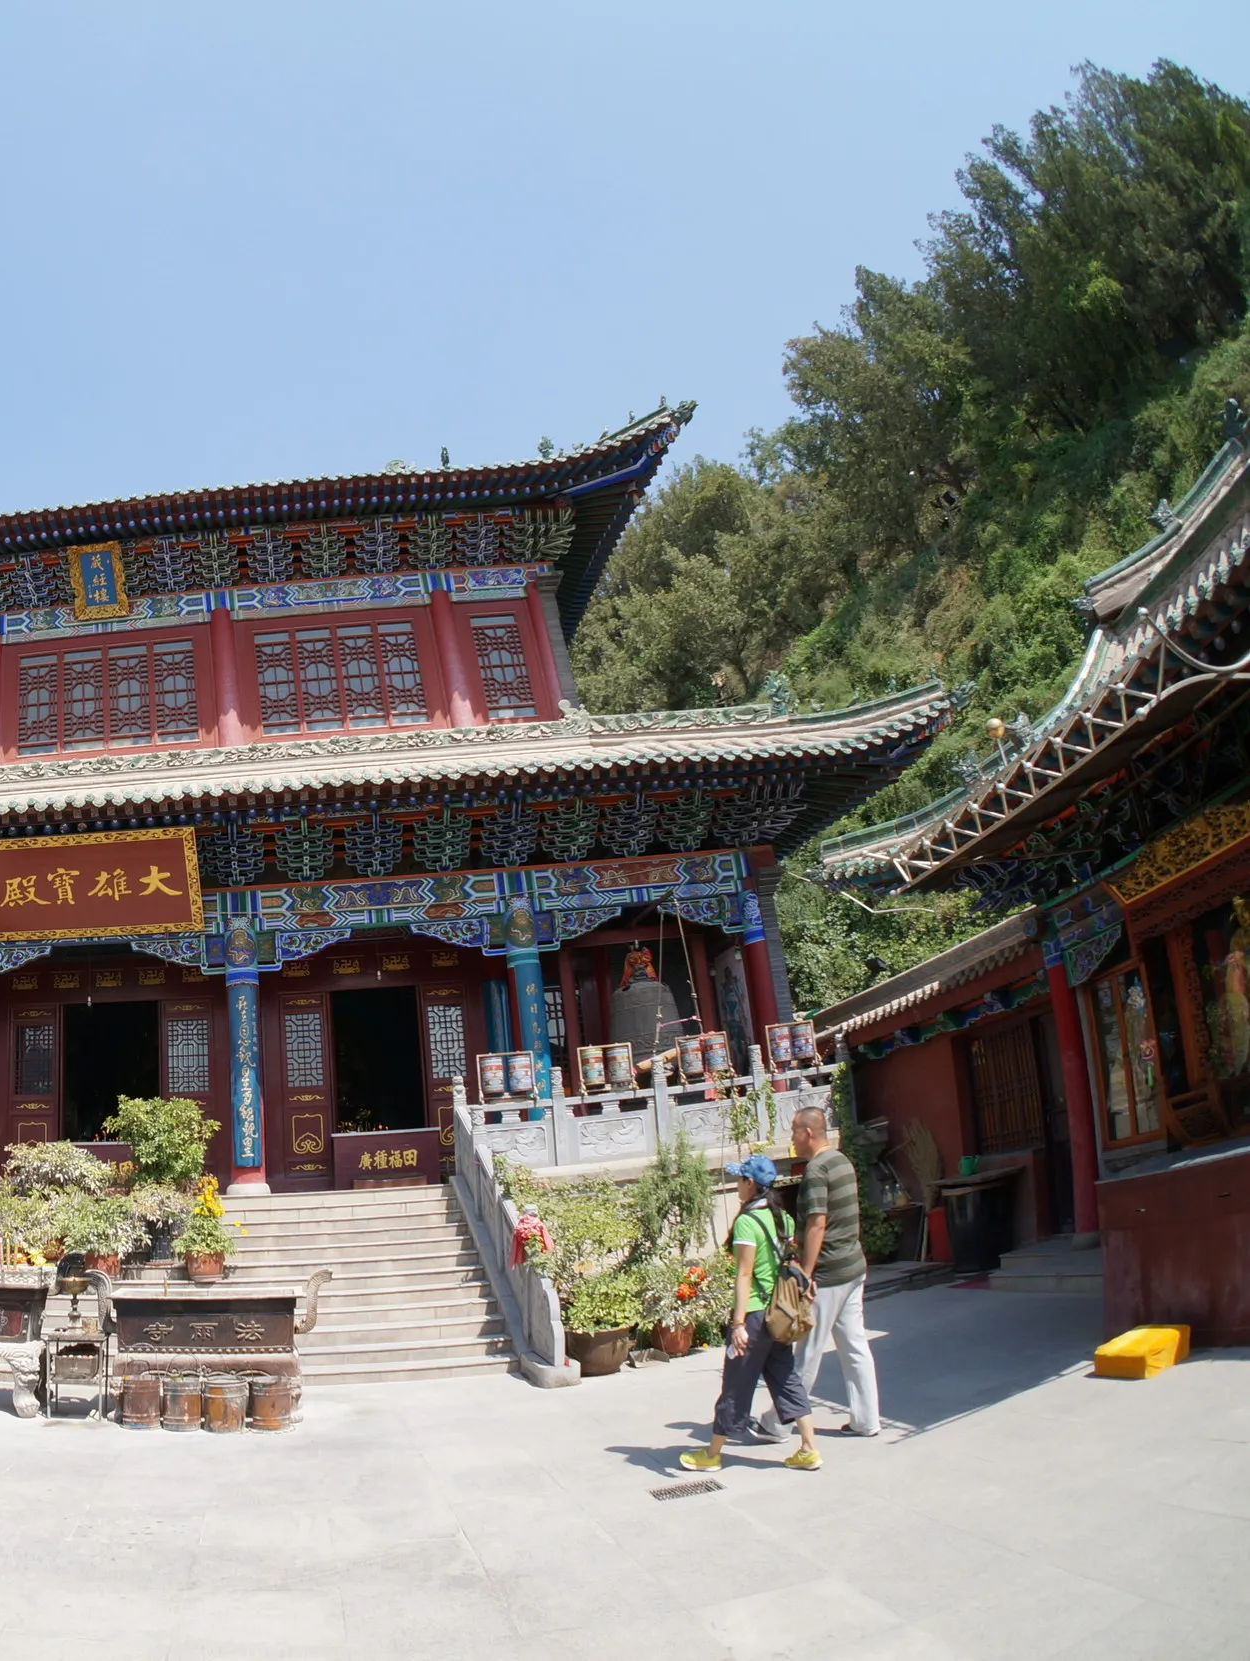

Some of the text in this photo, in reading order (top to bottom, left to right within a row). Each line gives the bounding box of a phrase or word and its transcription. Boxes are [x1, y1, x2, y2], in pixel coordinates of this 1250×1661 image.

[90, 553, 110, 604] 藏經樓
[0, 865, 183, 908] 大雄寶殿
[358, 1148, 419, 1171] 廣種福田
[143, 1320, 266, 1343] 法雨寺
